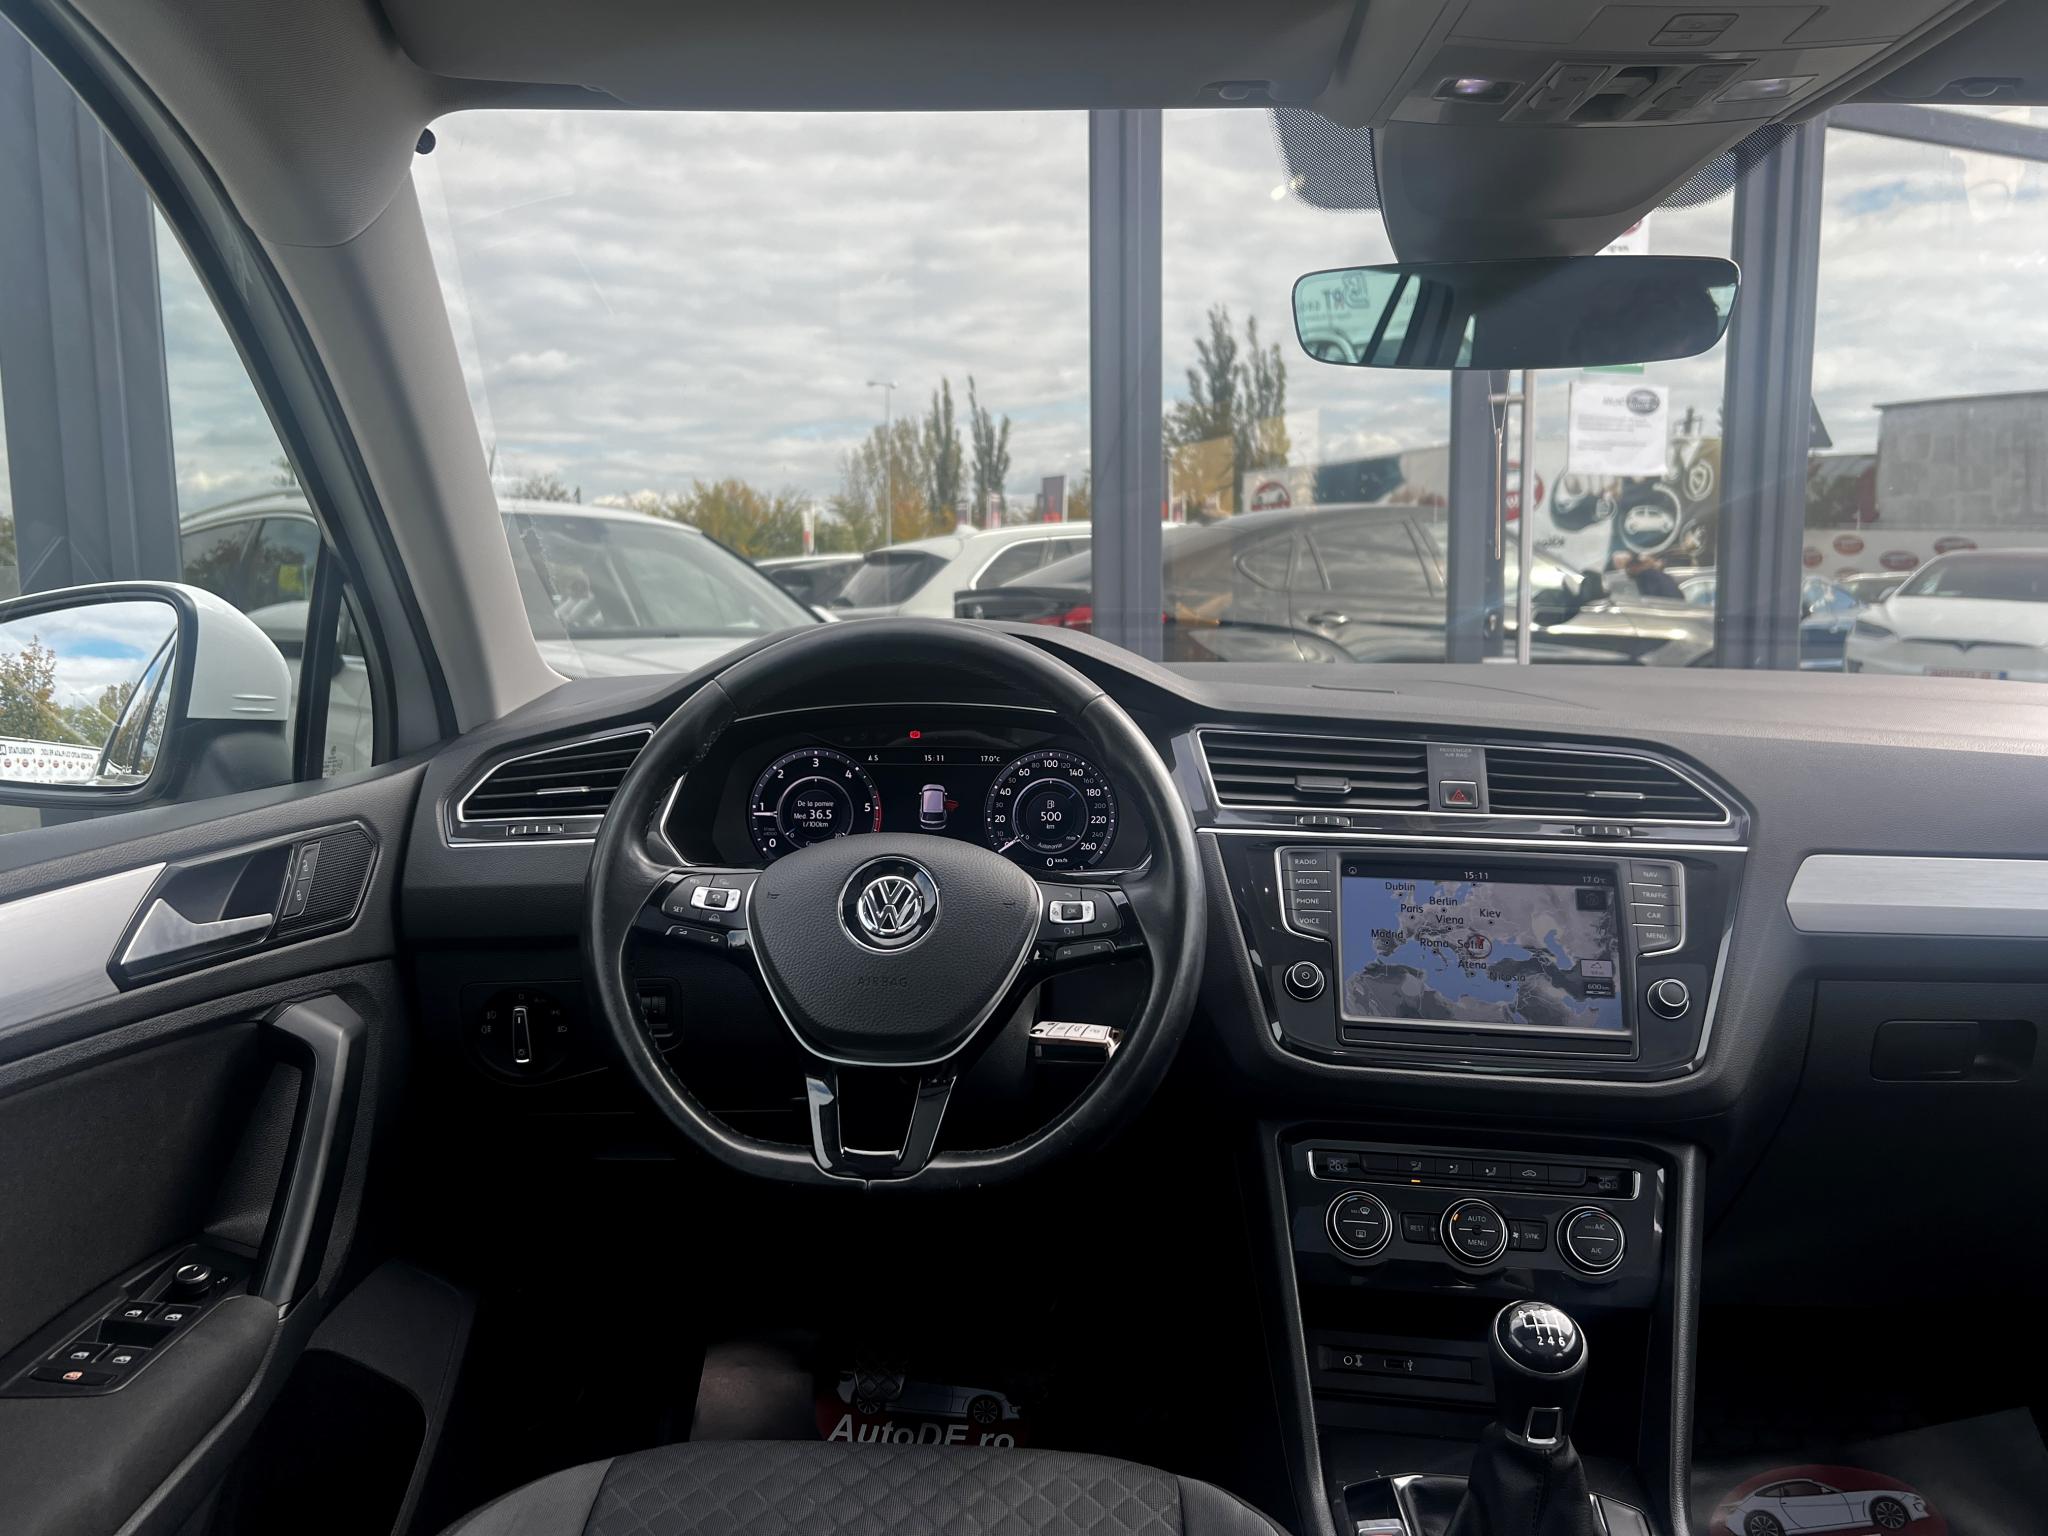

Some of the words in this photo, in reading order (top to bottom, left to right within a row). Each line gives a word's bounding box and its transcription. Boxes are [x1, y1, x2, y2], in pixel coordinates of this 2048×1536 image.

[812, 758, 819, 767] 3
[778, 770, 784, 778] 2
[846, 770, 852, 778] 4
[865, 803, 870, 812] 5
[809, 810, 832, 819] 36.5
[1041, 812, 1061, 821] 500
[1091, 816, 1106, 824] 220
[769, 839, 776, 847] 0
[1046, 858, 1053, 866] 0
[1464, 871, 1488, 880] 15:11
[1385, 882, 1415, 891] Dublin
[1429, 896, 1457, 906] Berlin
[1400, 904, 1423, 914] Paris
[1479, 908, 1501, 918] Kiev
[1436, 915, 1463, 925] Viena
[1371, 929, 1403, 939] Madrid
[1420, 938, 1448, 948] Roma
[1457, 960, 1486, 970] Atena
[1467, 1215, 1487, 1223] AUTO
[1410, 1224, 1424, 1232] REST
[1524, 1232, 1540, 1240] SYNC
[1467, 1239, 1488, 1247] MENU
[1537, 1336, 1544, 1345] 2
[1548, 1336, 1554, 1345] 4
[1559, 1337, 1565, 1346] 6
